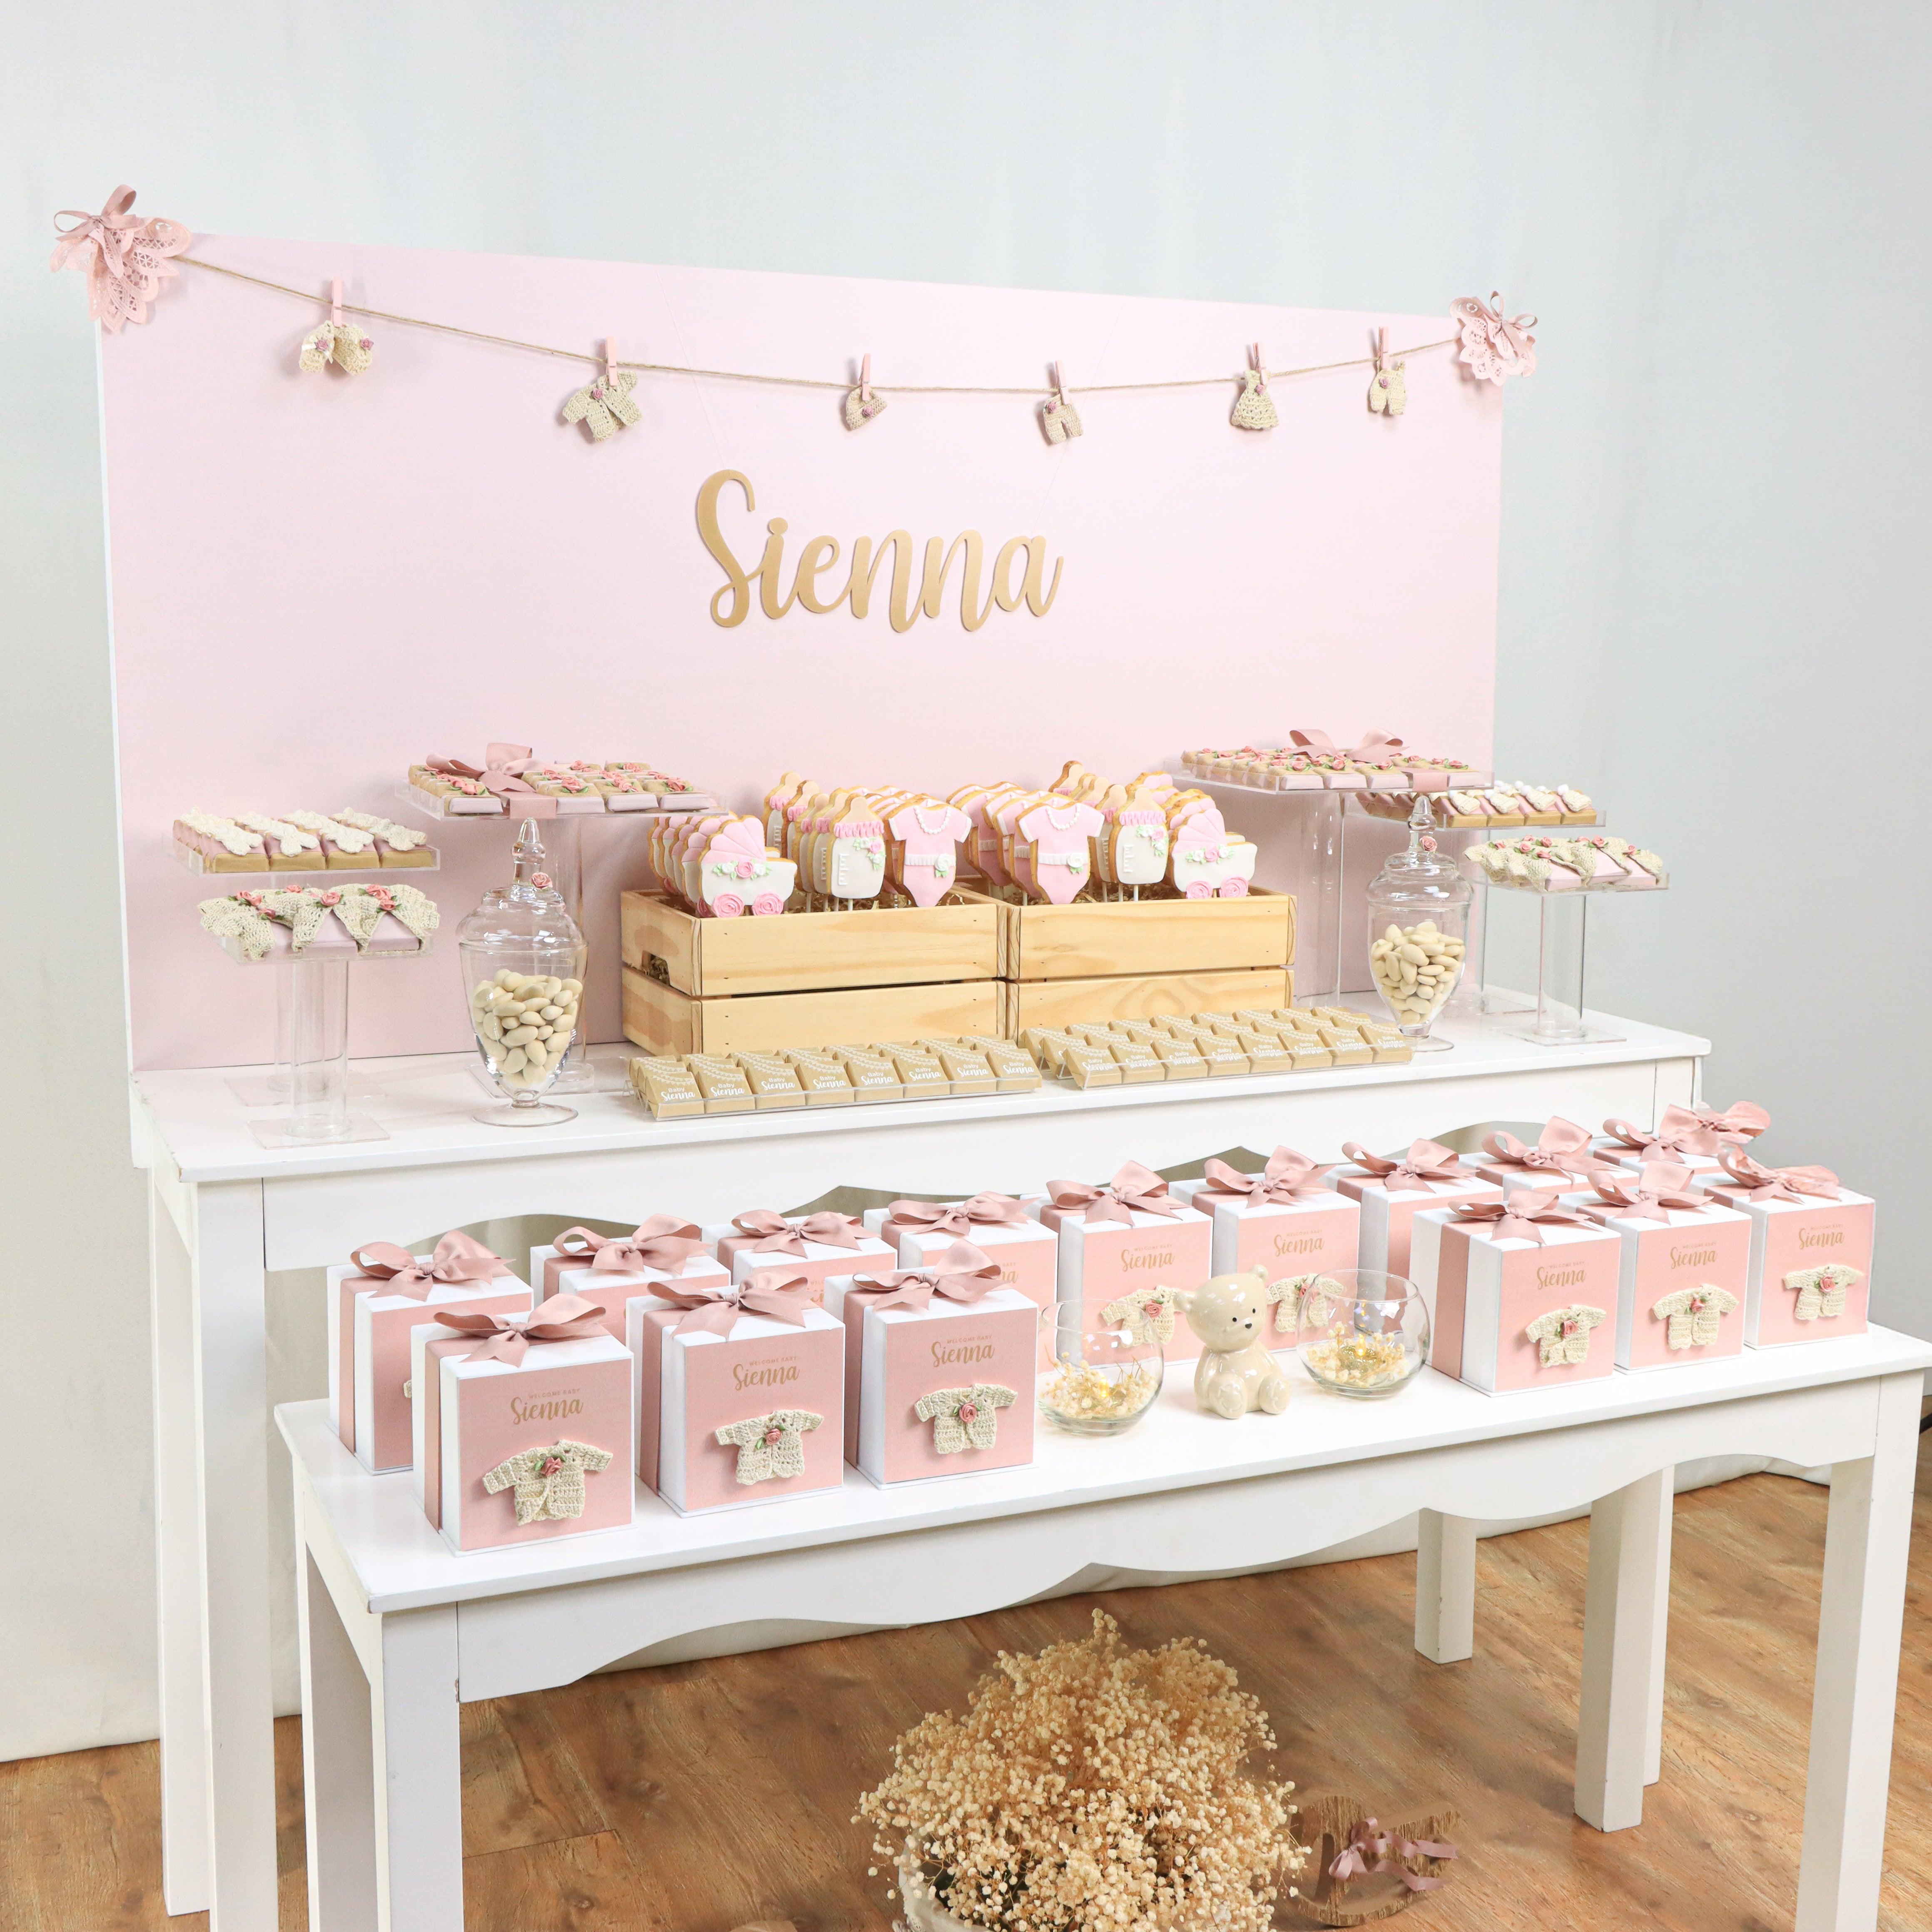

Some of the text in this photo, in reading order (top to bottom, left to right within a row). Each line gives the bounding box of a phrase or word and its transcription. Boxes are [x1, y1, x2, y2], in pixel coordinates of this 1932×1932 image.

[695, 469, 1064, 632] Sienna
[909, 1071, 941, 1081] Sienna
[957, 1067, 988, 1077] Sienna
[1003, 1065, 1034, 1074] Sienna
[761, 1081, 795, 1090] Sienna
[813, 1079, 846, 1089] Sienna
[861, 1076, 894, 1086] Sienna
[661, 1091, 695, 1101] Sienna
[710, 1086, 744, 1097] Sienna
[1274, 1235, 1325, 1257] Sienna
[1799, 1228, 1845, 1250] Sienna
[1121, 1249, 1175, 1272] Sienna
[1670, 1247, 1718, 1270] Sienna
[1537, 1266, 1586, 1290] Sienna
[931, 1341, 995, 1367] Sienna
[733, 1364, 800, 1391] Sienna
[529, 1391, 560, 1399] WELCOME
[510, 1397, 583, 1425] Sienna
